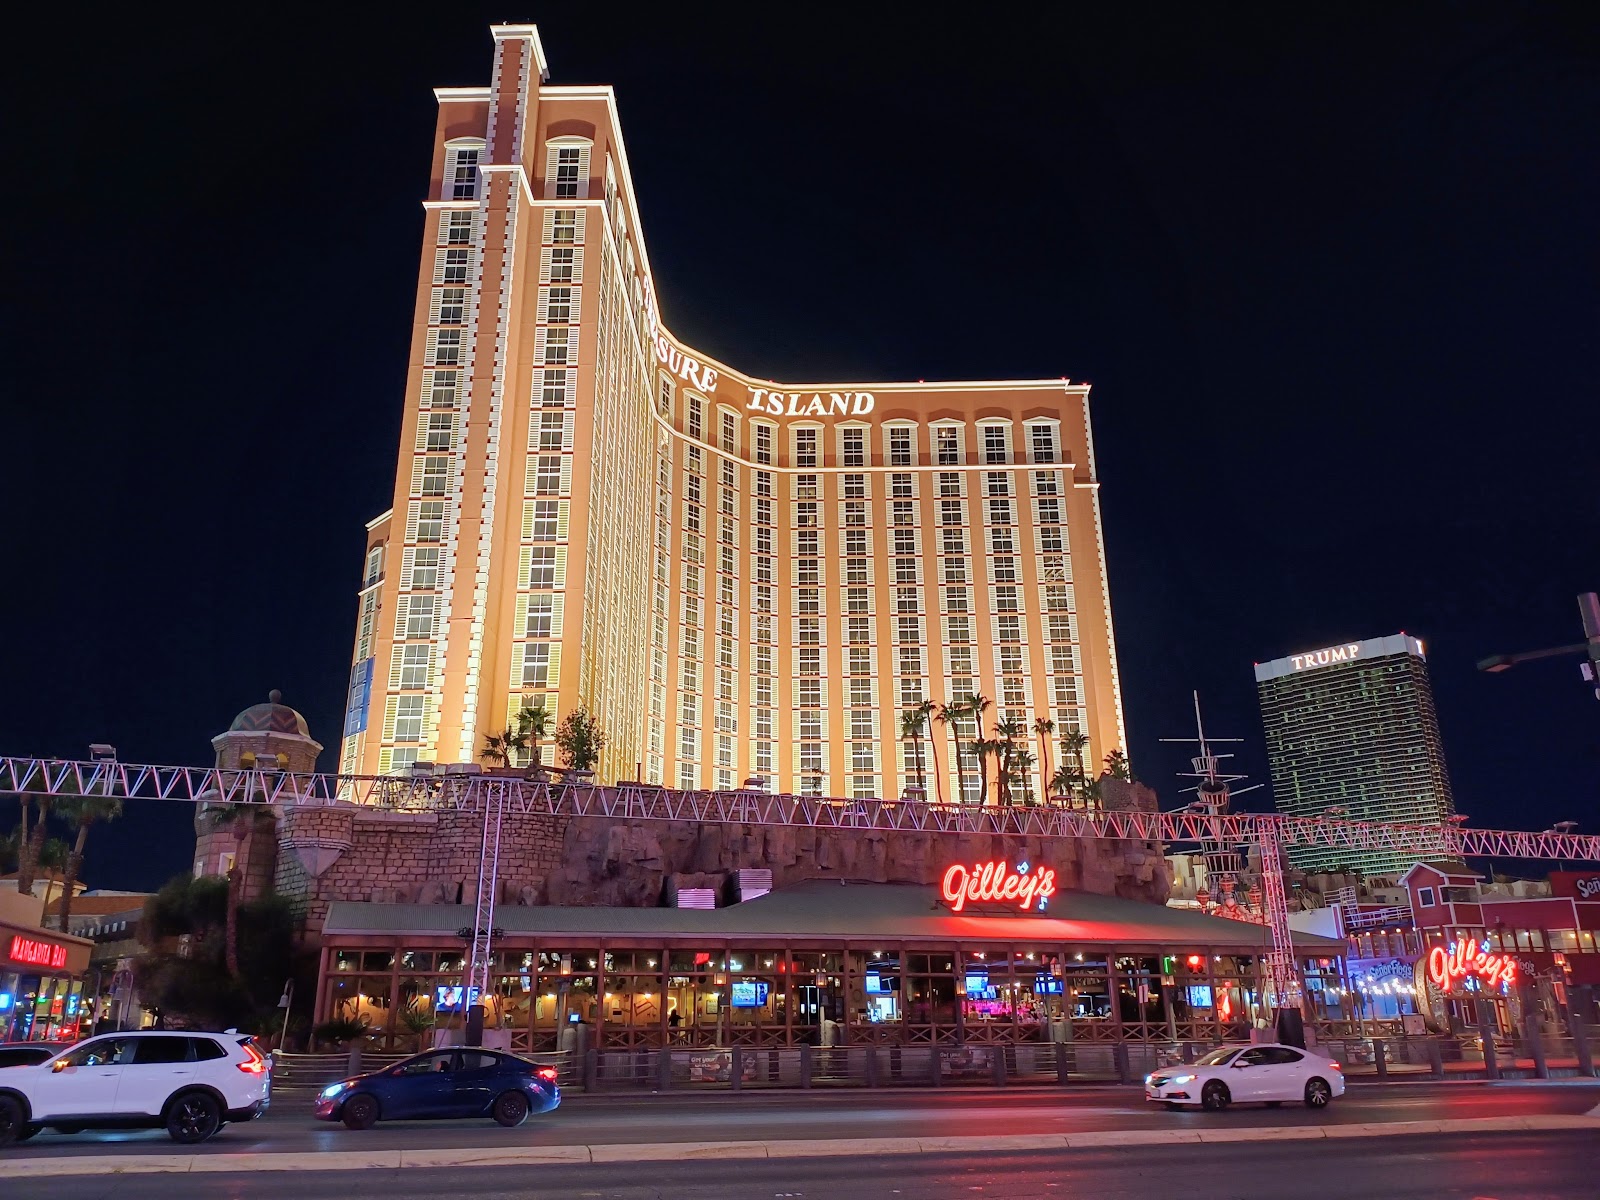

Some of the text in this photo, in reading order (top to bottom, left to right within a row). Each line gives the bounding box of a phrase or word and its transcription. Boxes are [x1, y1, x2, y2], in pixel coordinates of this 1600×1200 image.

[746, 386, 875, 416] ISLAND
[1291, 644, 1359, 670] TRUMP
[943, 861, 1055, 911] Gilley's
[1430, 938, 1516, 990] Gilley's
